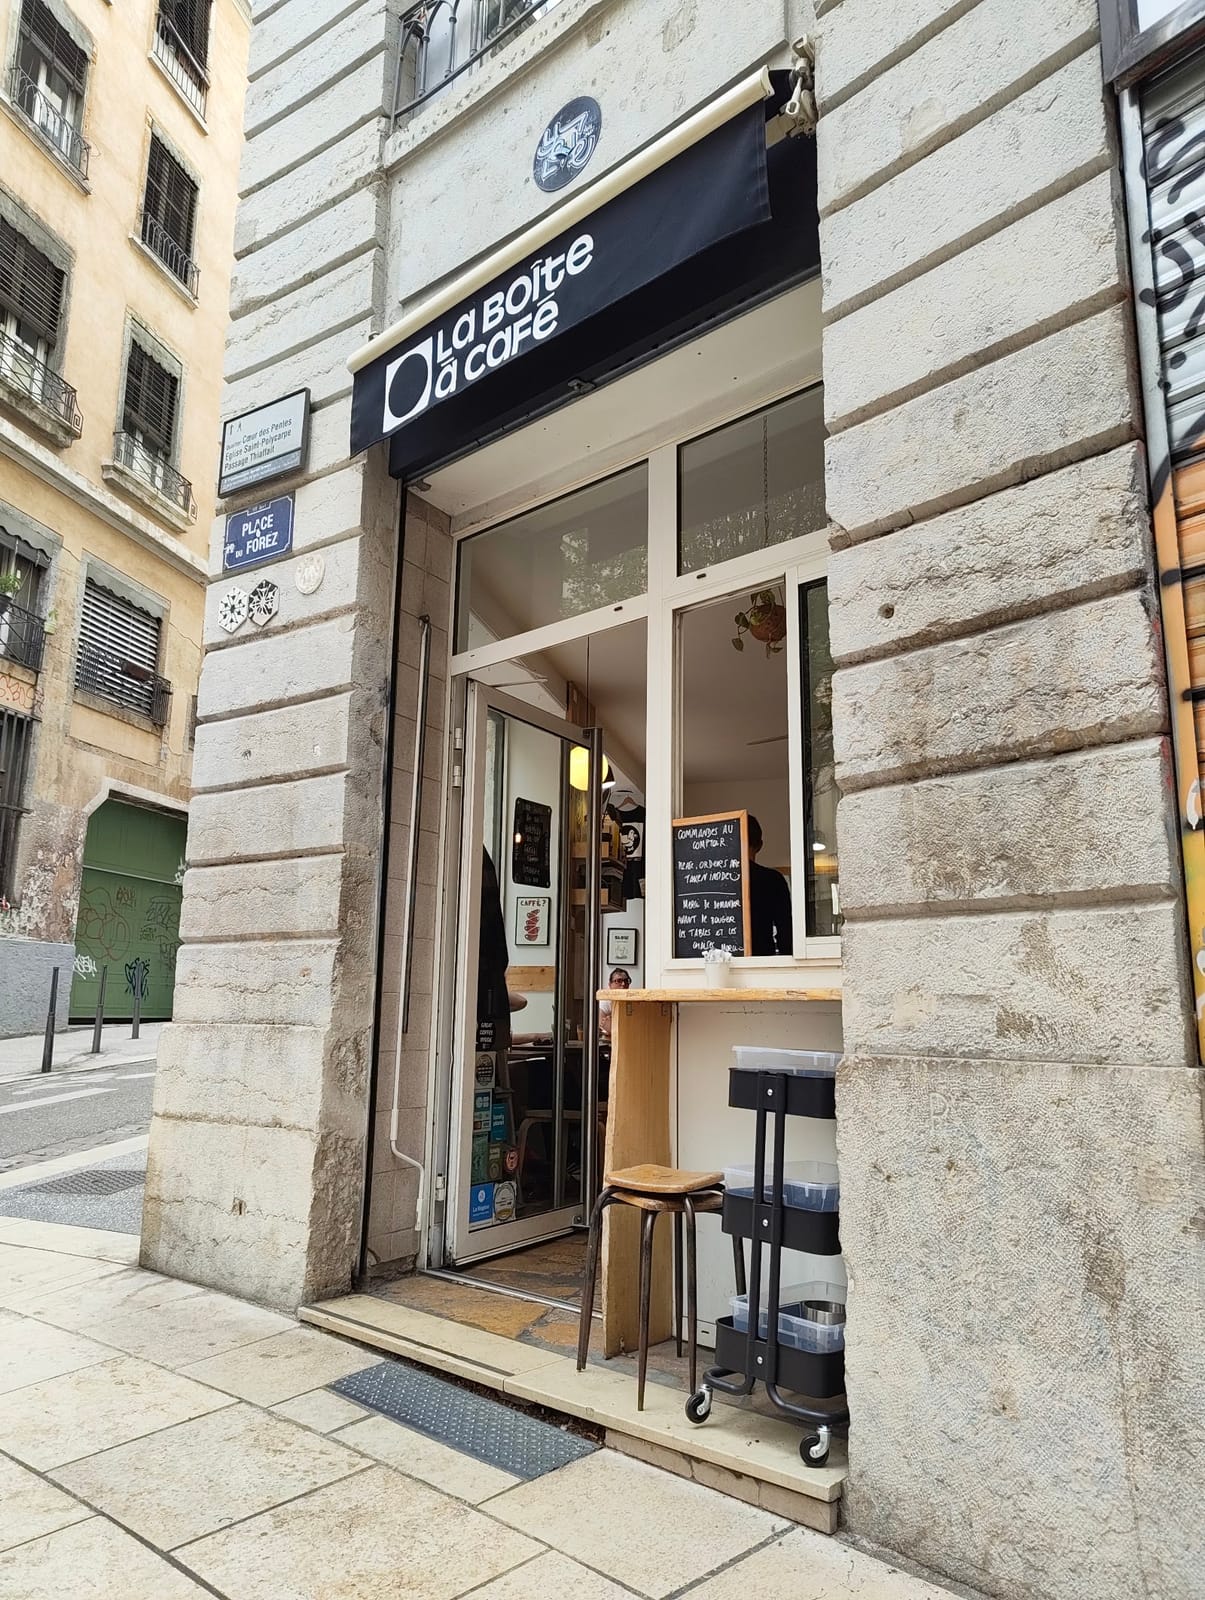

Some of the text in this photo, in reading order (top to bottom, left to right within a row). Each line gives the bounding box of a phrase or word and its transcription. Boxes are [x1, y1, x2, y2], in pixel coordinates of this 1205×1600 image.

[437, 308, 475, 363] La
[258, 426, 269, 438] des
[224, 456, 249, 472] Passage
[242, 513, 274, 537] PLACE
[235, 549, 243, 559] DU
[246, 531, 279, 555] FOREZ
[722, 824, 734, 835] AU
